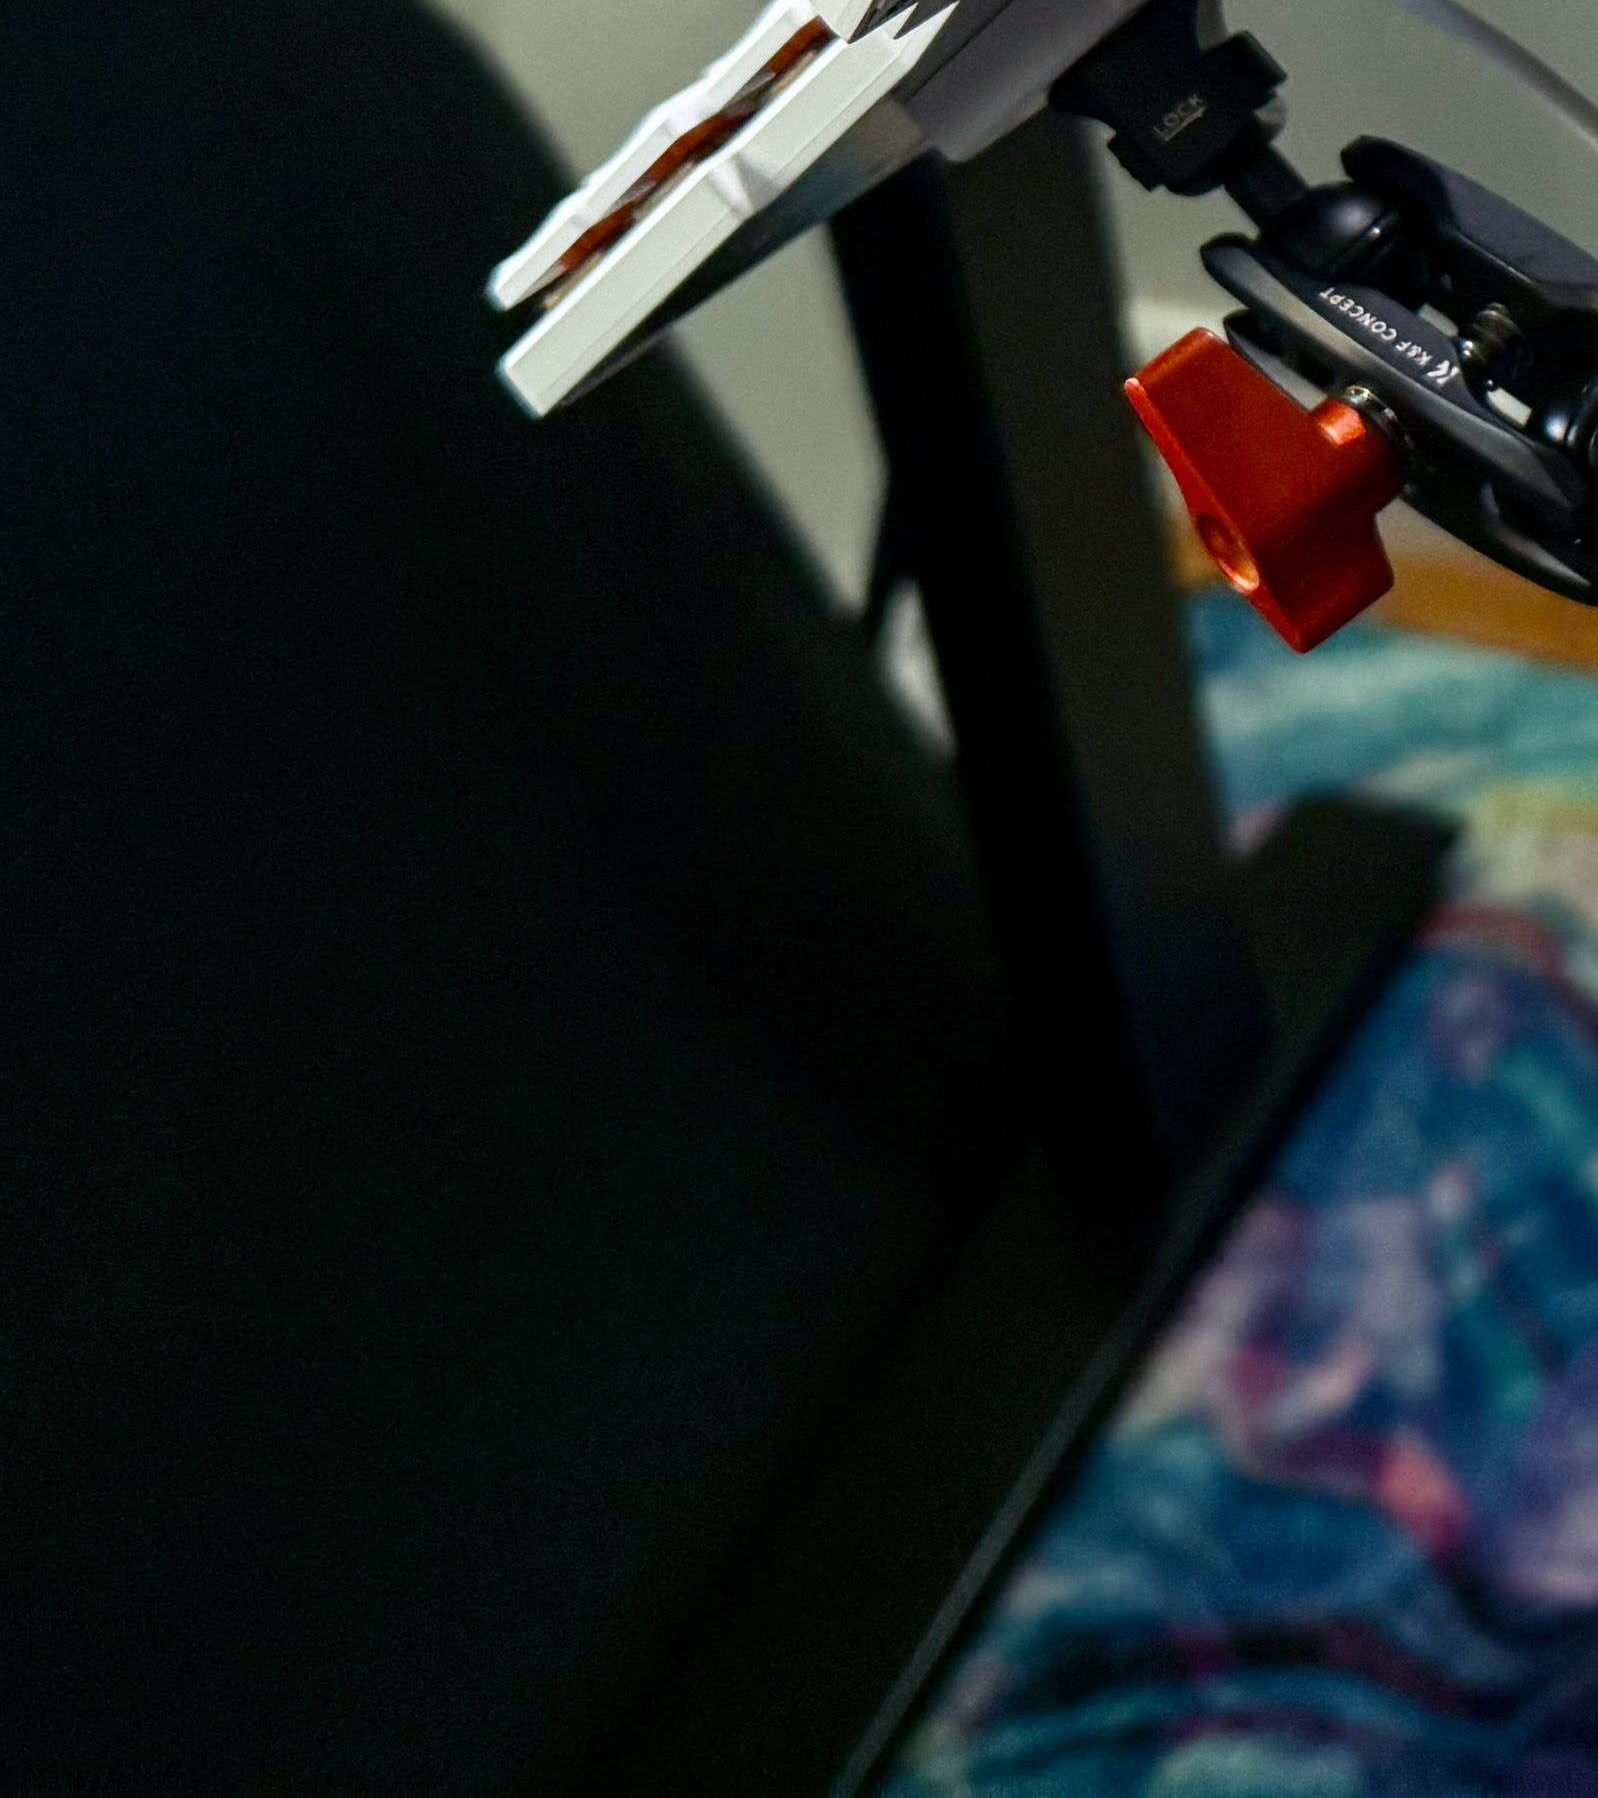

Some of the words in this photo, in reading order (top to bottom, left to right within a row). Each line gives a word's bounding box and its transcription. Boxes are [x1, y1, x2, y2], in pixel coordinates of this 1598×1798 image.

[1152, 92, 1204, 138] LOCK
[1318, 286, 1399, 341] CONCEPT
[1394, 340, 1434, 367] K&F
